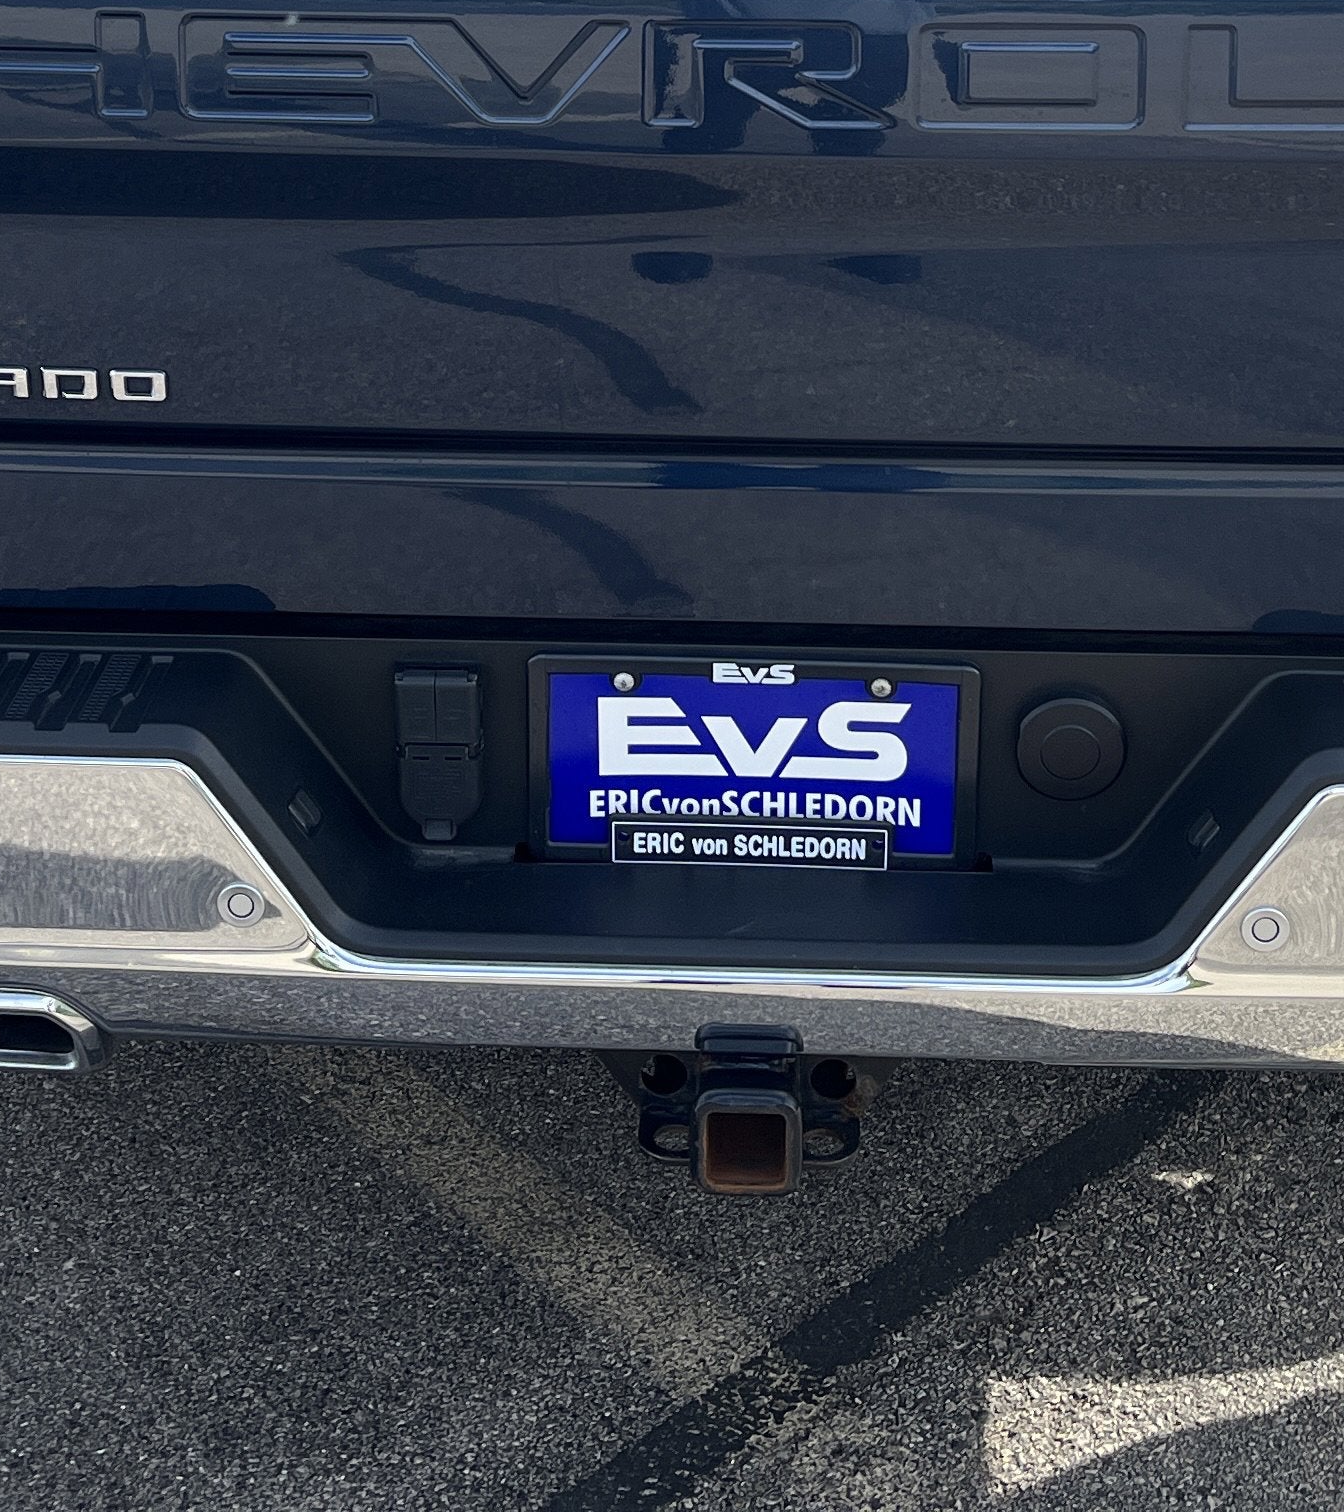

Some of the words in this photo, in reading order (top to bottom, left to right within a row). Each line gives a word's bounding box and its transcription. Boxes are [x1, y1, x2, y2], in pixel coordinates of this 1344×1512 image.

[589, 788, 921, 828] ERICvonSCHLEDORN
[632, 832, 685, 855] ERIC
[691, 838, 728, 856] von
[733, 835, 867, 860] SCHLEDORN
